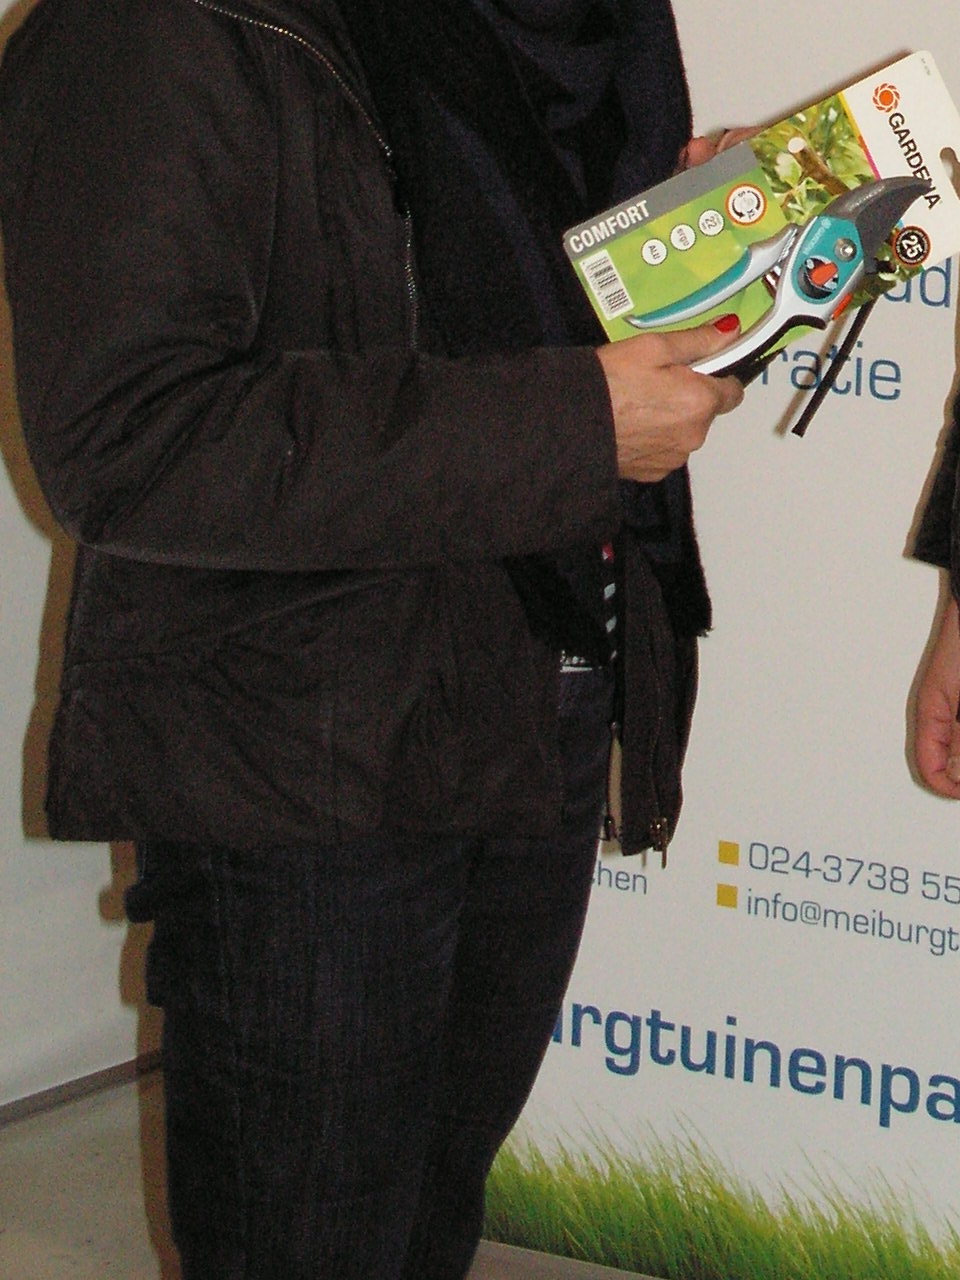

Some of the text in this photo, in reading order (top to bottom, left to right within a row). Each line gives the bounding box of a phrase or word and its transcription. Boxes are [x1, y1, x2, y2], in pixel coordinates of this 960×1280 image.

[888, 112, 942, 210] GARDEA
[569, 200, 650, 253] COMFORT
[900, 234, 923, 259] 25
[591, 861, 648, 895] hen
[748, 842, 911, 896] 024-3738
